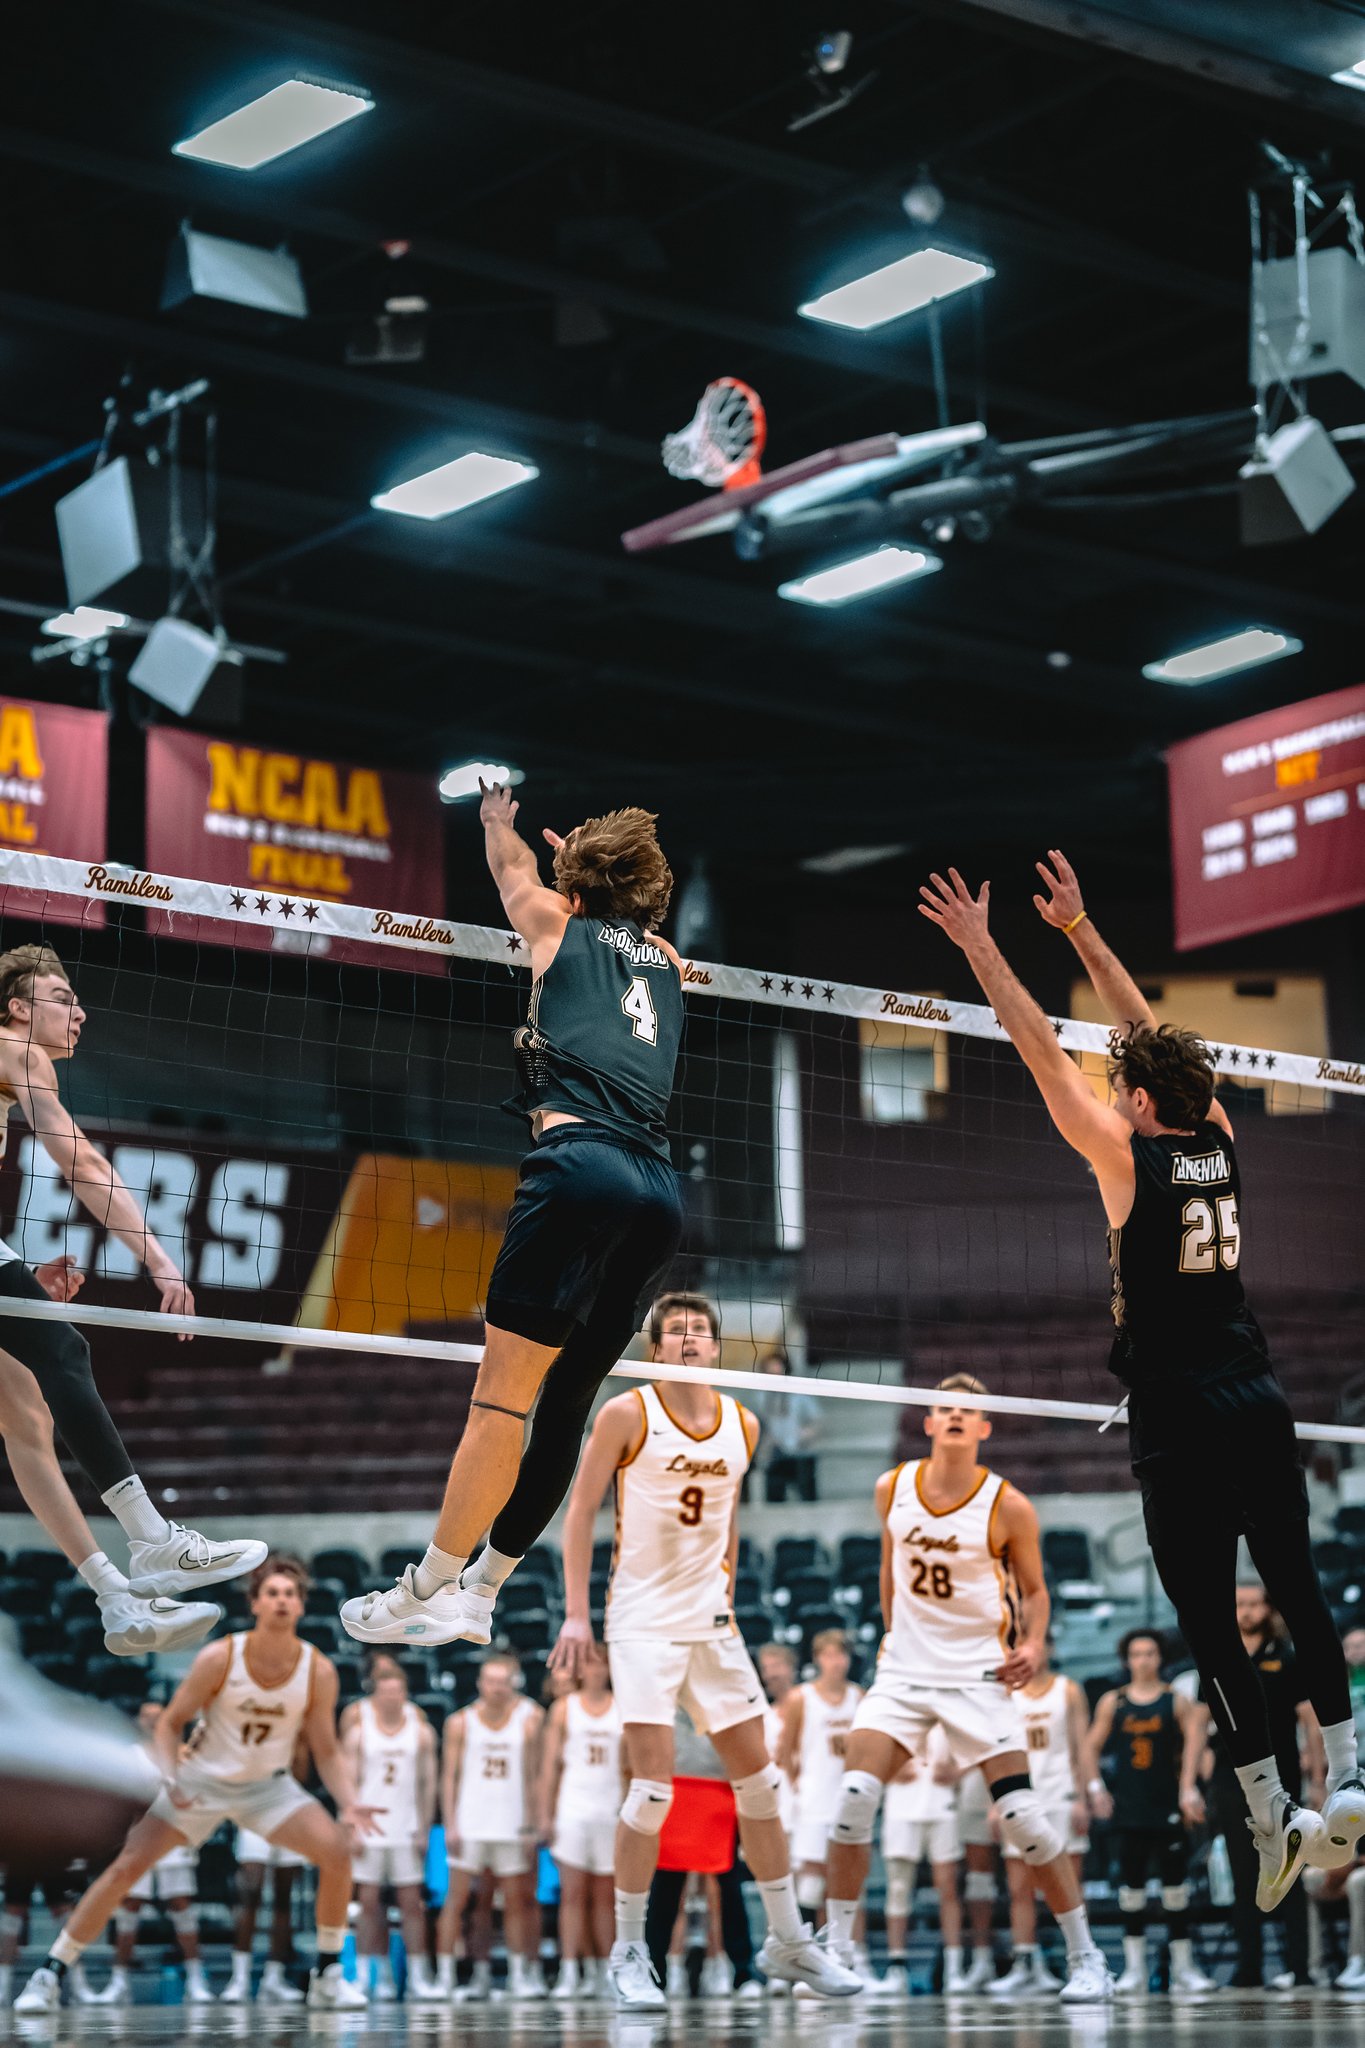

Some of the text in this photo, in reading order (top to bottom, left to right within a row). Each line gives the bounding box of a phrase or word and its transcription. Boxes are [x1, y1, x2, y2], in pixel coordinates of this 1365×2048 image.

[207, 742, 390, 838] NCAA
[84, 865, 174, 901] Ramblers
[371, 911, 455, 945] Ramblers
[684, 961, 713, 985] lers
[621, 976, 658, 1047] 4
[880, 993, 952, 1022] Ramblers
[1315, 1058, 1365, 1085] Ramble
[1178, 1192, 1241, 1273] 25
[665, 1454, 729, 1478] Loyola
[678, 1486, 704, 1527] 9
[903, 1526, 959, 1553] Loyola
[910, 1557, 953, 1599] 28
[242, 1722, 272, 1745] 17
